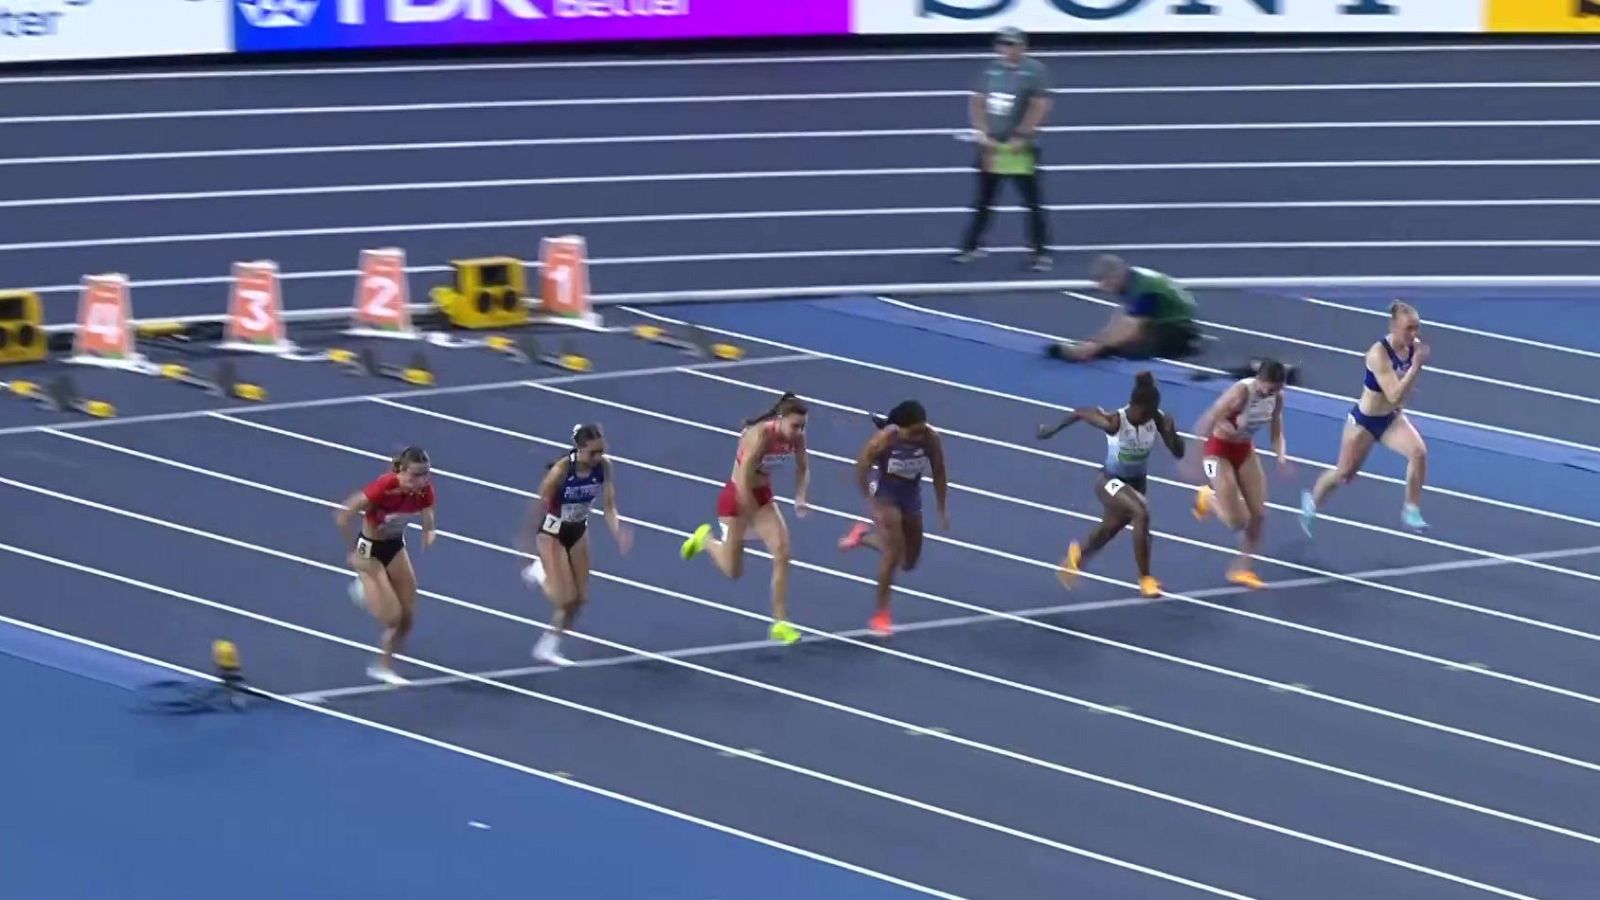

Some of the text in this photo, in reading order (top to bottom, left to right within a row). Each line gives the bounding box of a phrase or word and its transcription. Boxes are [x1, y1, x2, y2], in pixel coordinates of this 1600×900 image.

[362, 276, 399, 318] 2
[548, 265, 572, 304] 1
[87, 302, 119, 344] 4
[238, 290, 271, 331] 3
[547, 517, 557, 529] 7
